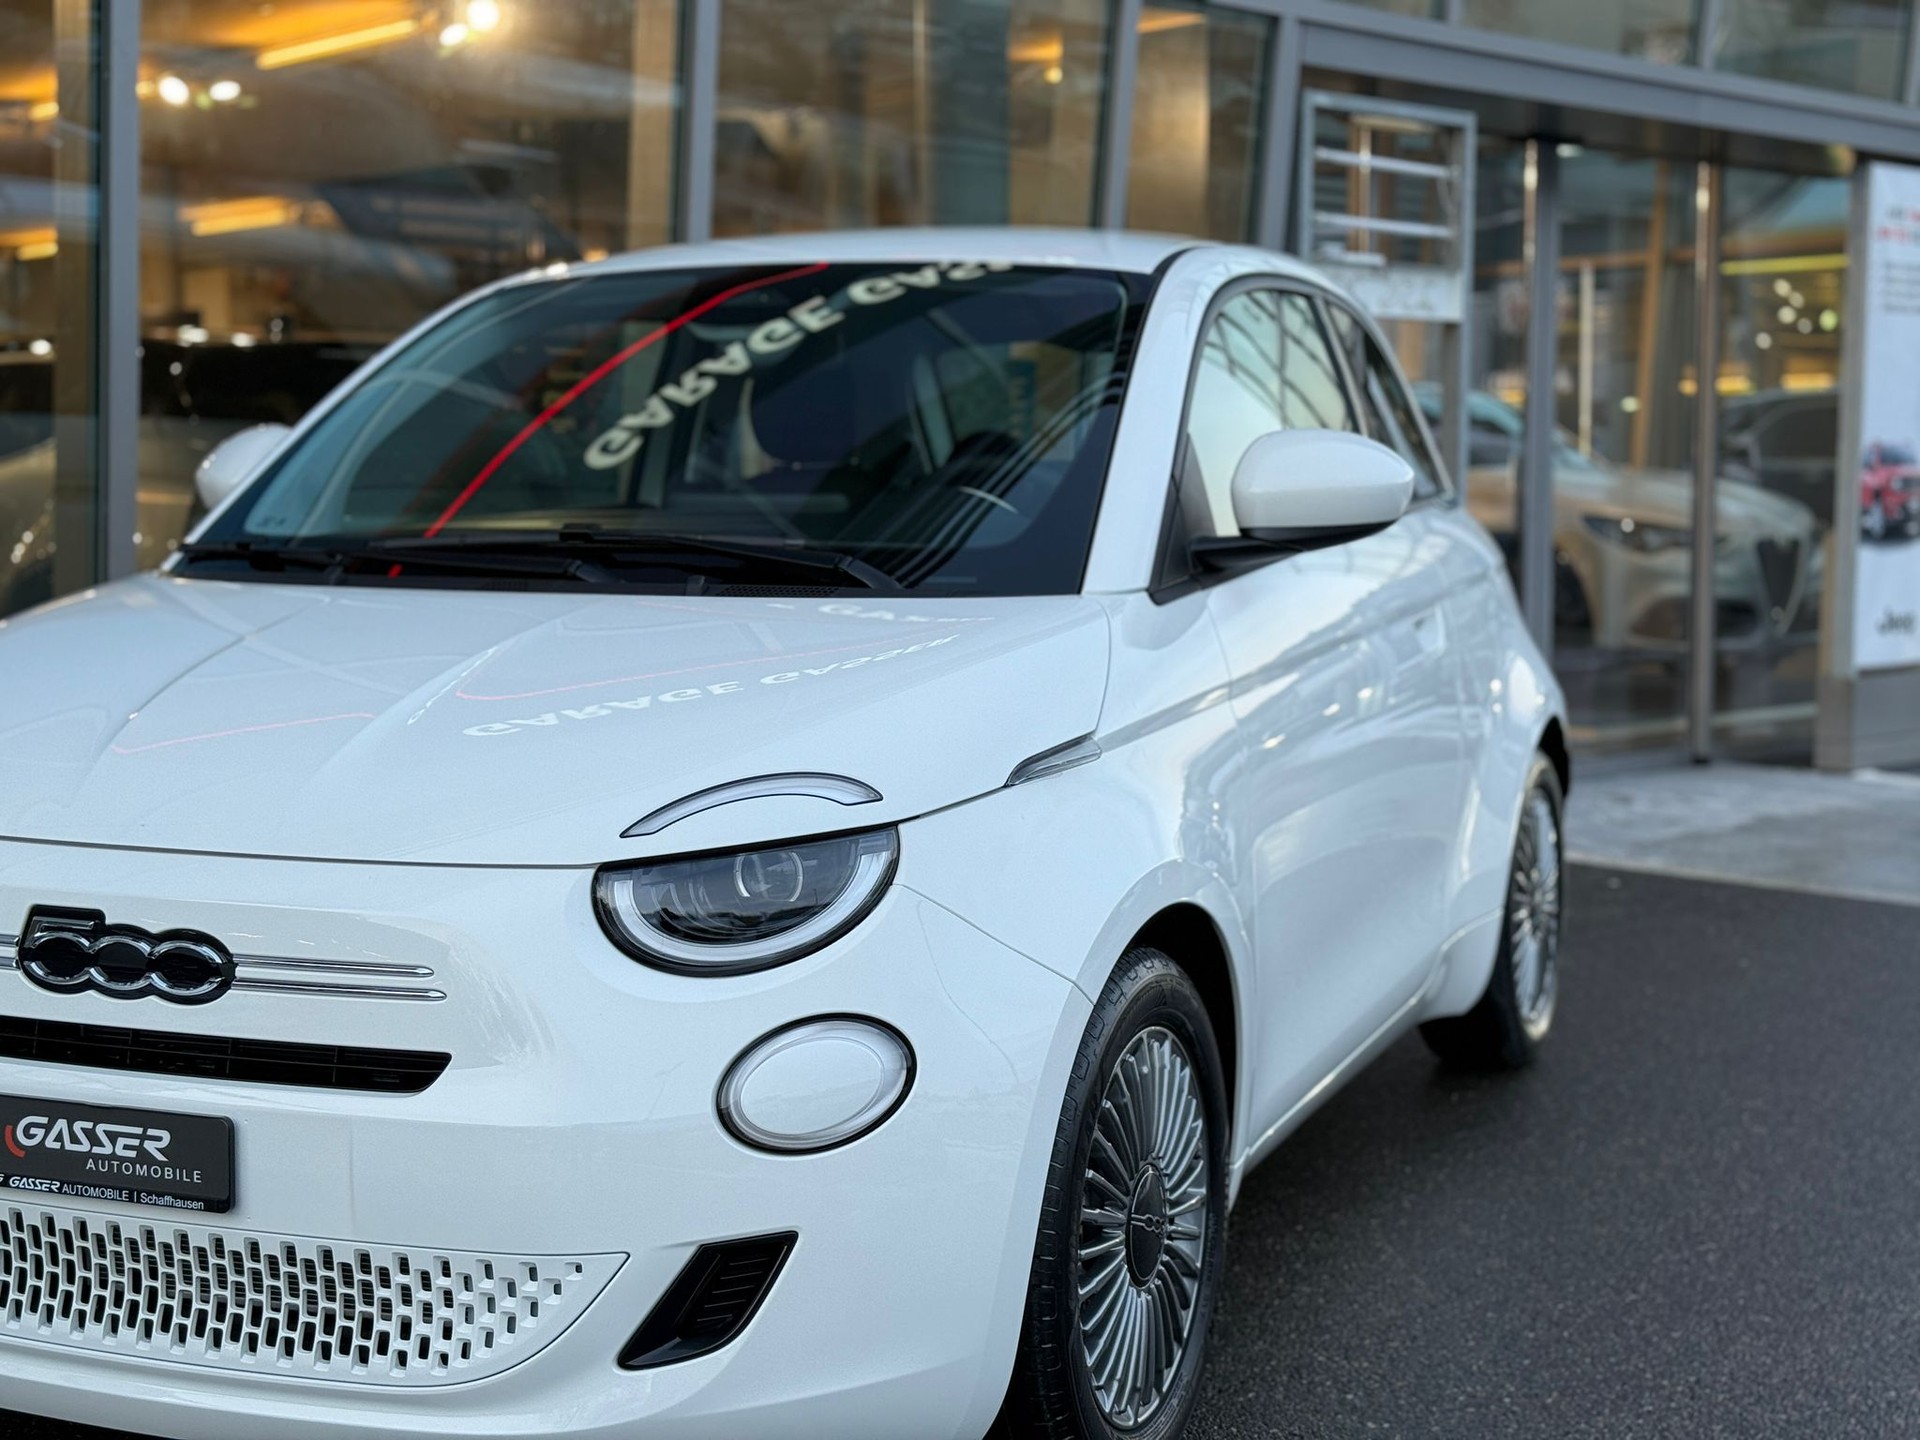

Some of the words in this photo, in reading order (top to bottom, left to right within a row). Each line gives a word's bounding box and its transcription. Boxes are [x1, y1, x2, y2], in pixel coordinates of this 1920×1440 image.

[16, 1115, 171, 1162] GASSER
[86, 1158, 203, 1183] AUTOMOBILE
[8, 1175, 61, 1193] GASSER
[62, 1183, 130, 1201] AUTOMOBILE
[140, 1192, 204, 1210] Schaffhausen
